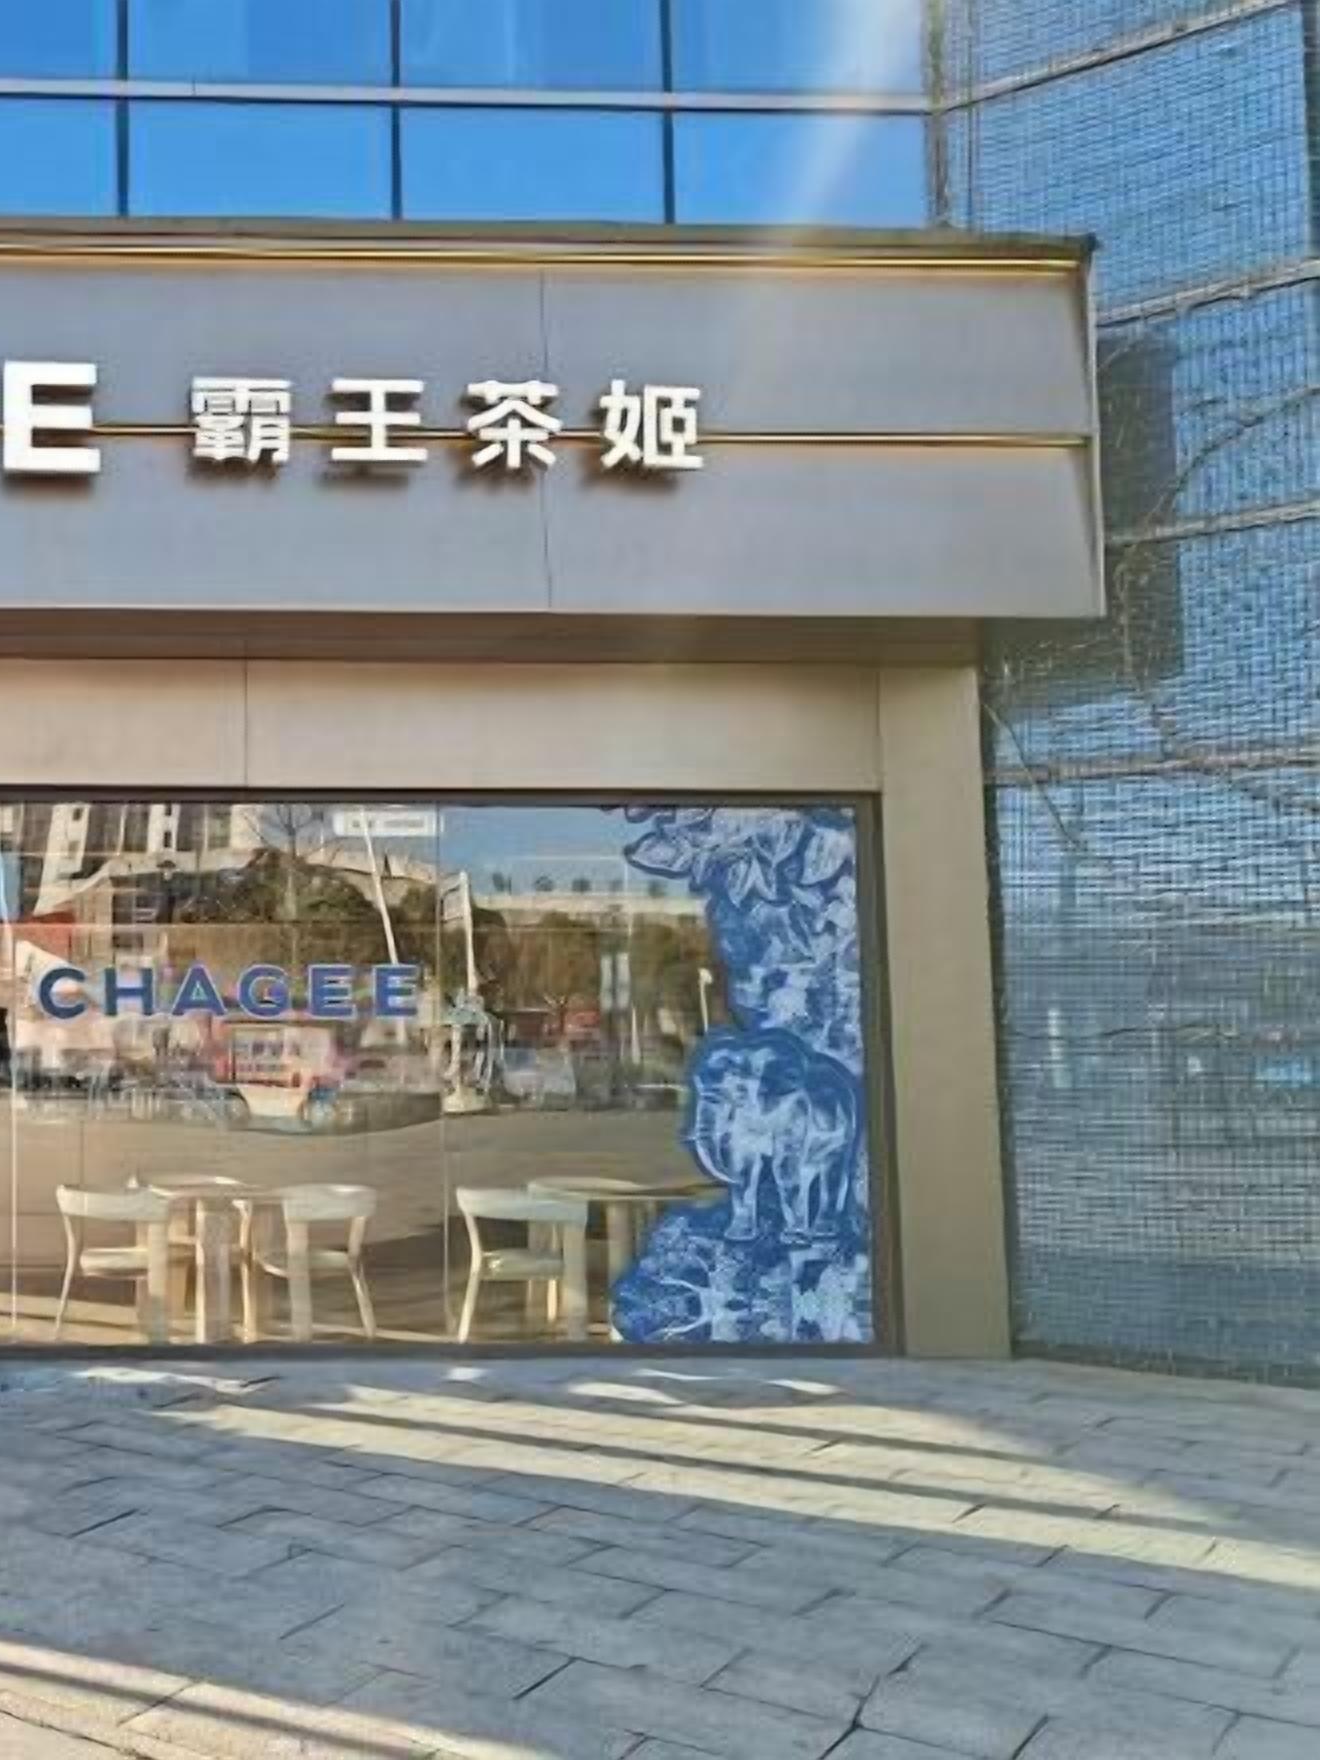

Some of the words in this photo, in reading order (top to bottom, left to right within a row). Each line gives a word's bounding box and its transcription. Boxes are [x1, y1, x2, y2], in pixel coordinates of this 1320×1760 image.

[191, 376, 704, 470] 霸王茶姬
[37, 962, 421, 1020] CHAGEE
